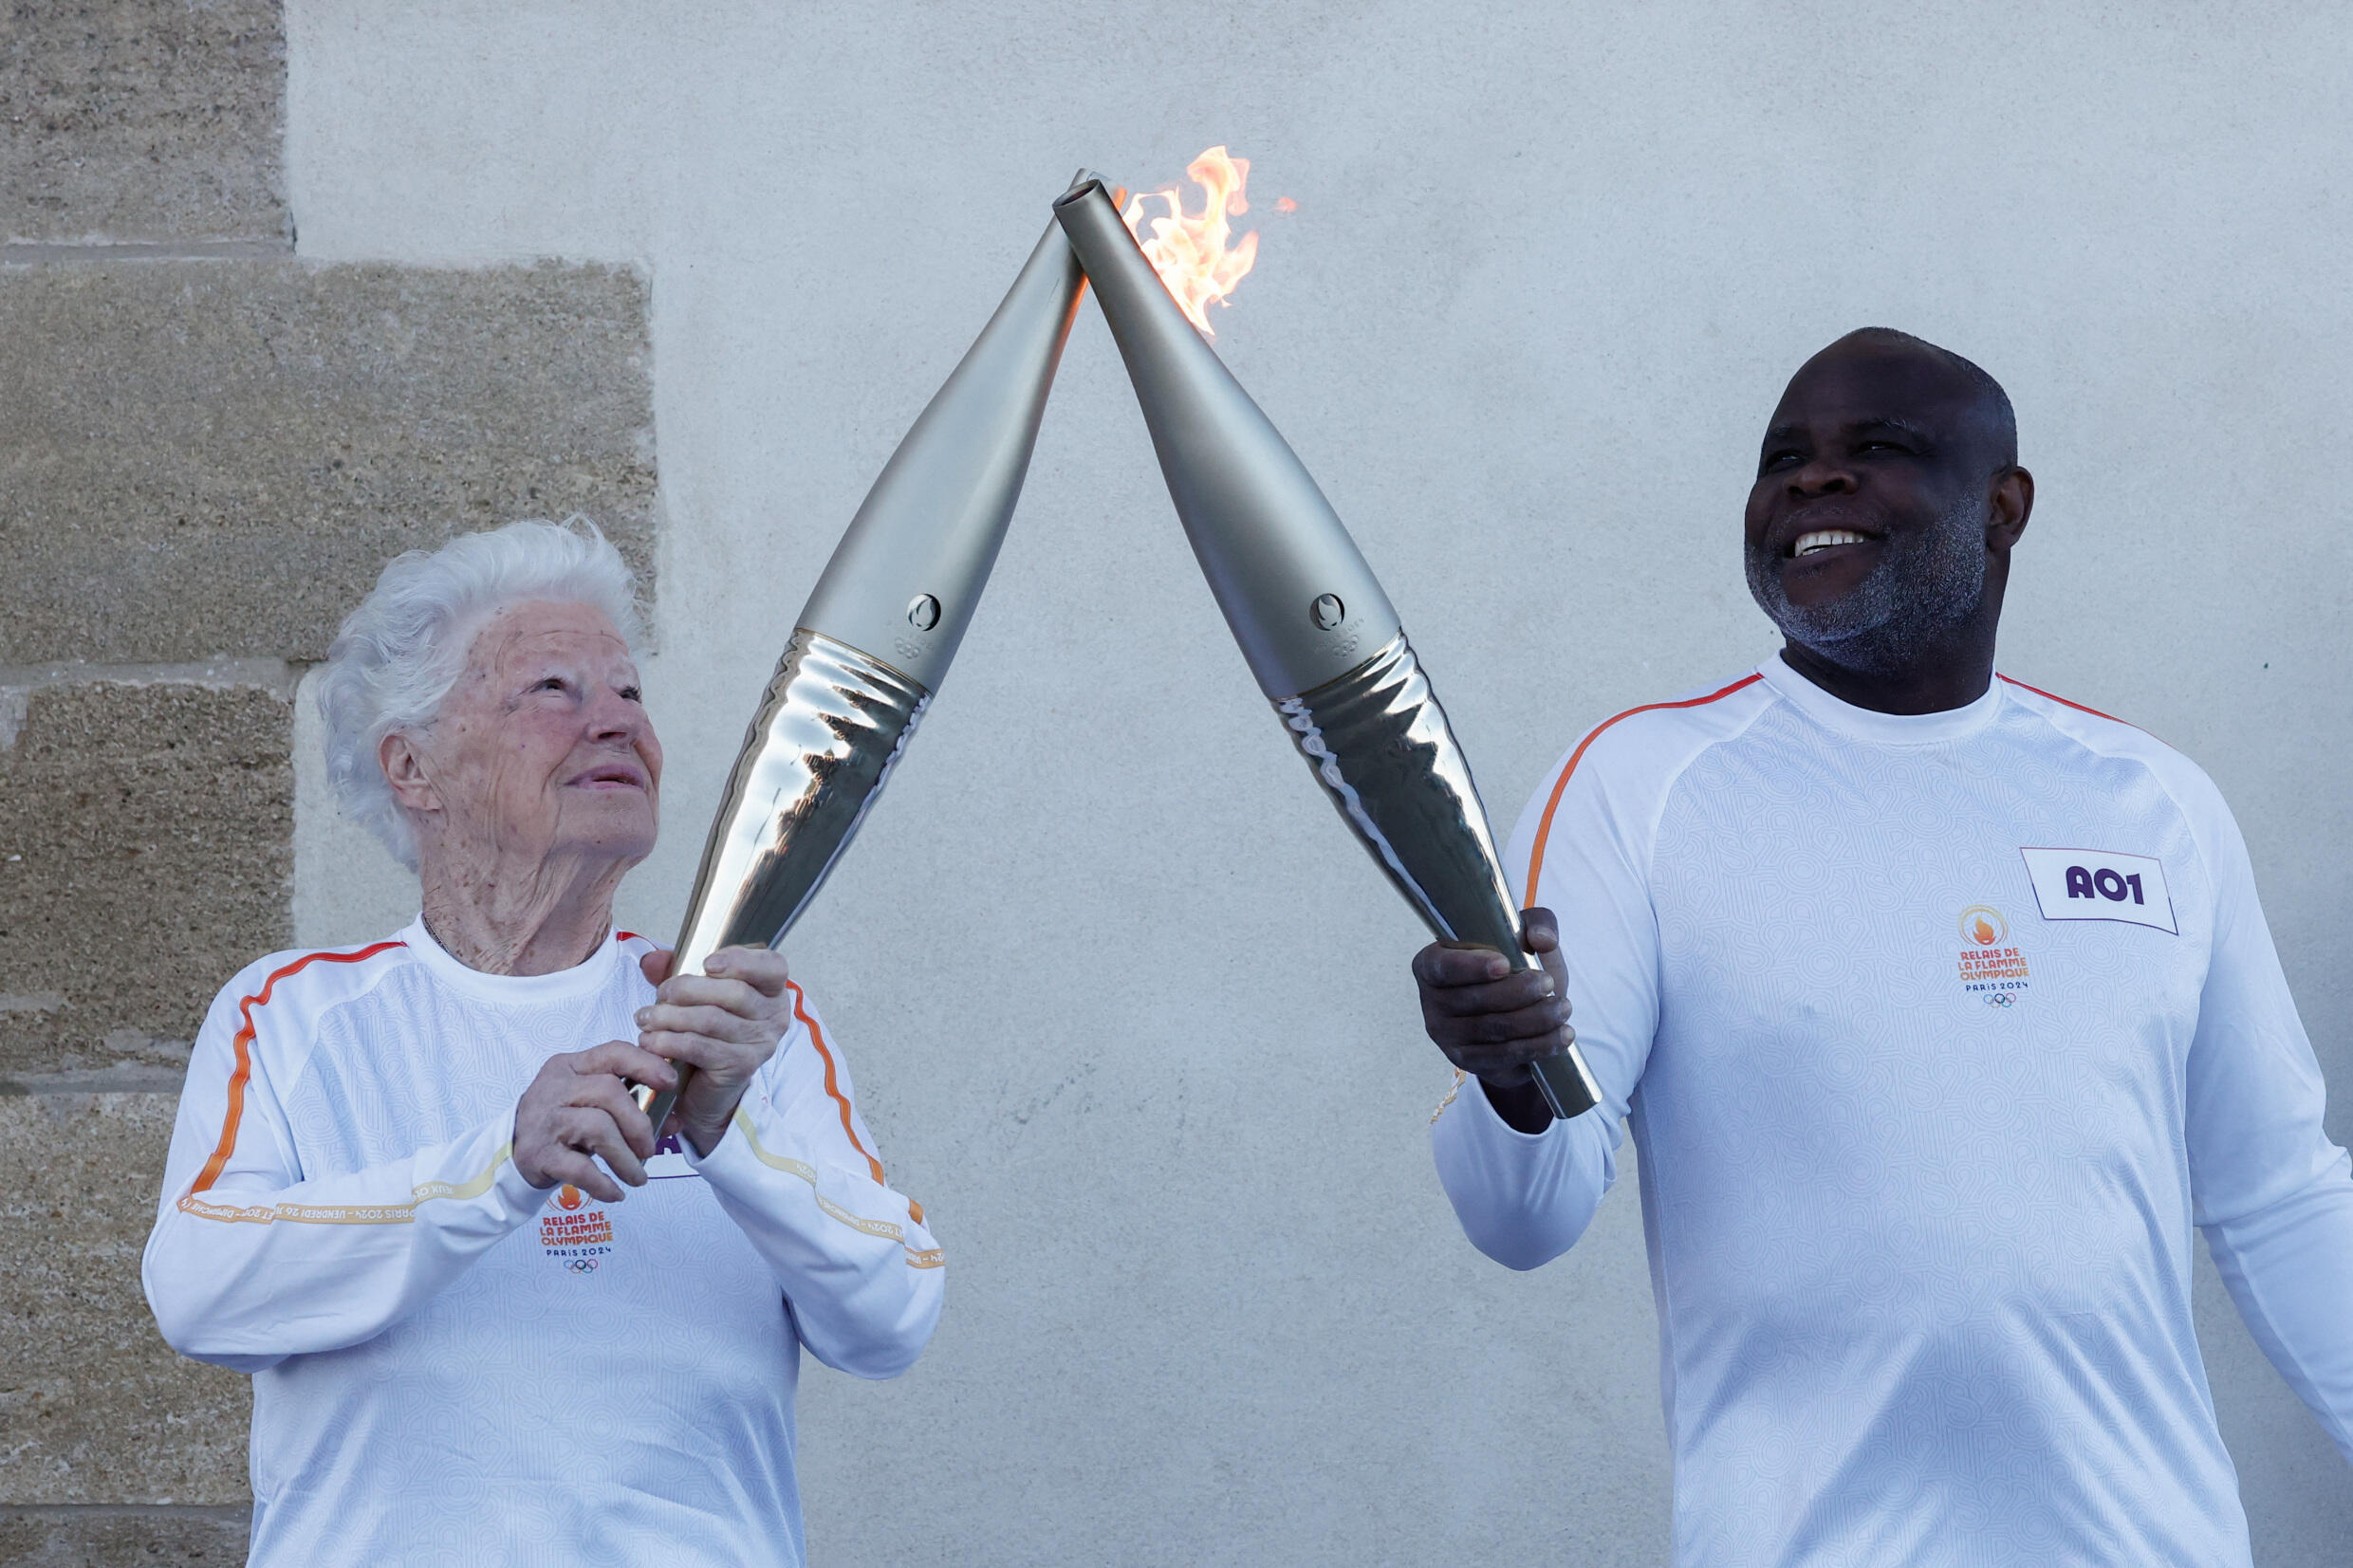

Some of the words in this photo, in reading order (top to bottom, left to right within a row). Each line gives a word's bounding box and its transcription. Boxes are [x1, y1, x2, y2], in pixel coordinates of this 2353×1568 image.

[1959, 949, 2002, 961] RELAIS
[2004, 948, 2020, 957] DE
[1957, 961, 1973, 971] LA
[1975, 957, 2028, 970] FLAMME
[1959, 968, 2029, 981] OLYMPIQUE
[1999, 981, 2029, 990] 2024
[286, 1207, 299, 1217] 26
[302, 1208, 346, 1220] VENDREDI
[356, 1208, 382, 1220] 2024
[542, 1213, 586, 1227] RELAIS
[588, 1210, 605, 1223] DE
[539, 1227, 554, 1236] LA
[557, 1221, 612, 1236] FLAMME
[541, 1232, 614, 1245] OLYMPIQUE
[581, 1246, 612, 1256] 2024
